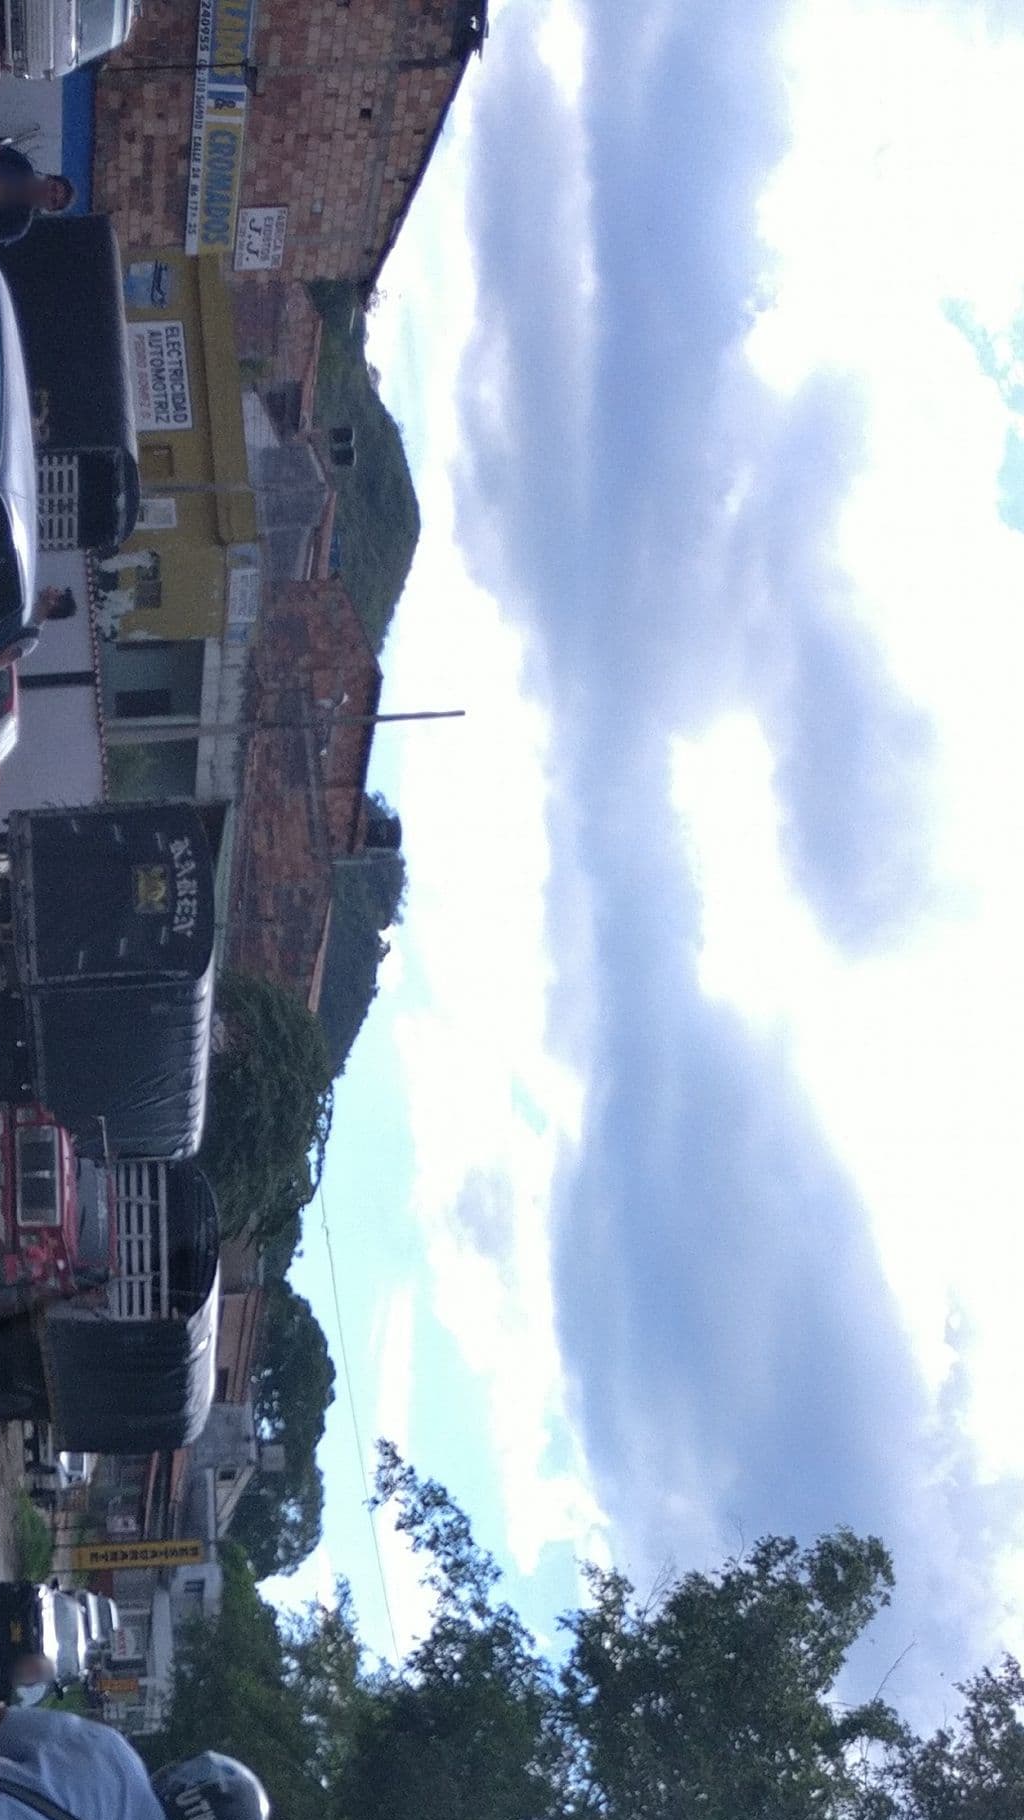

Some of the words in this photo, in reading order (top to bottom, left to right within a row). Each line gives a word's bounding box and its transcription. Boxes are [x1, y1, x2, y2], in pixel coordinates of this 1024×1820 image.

[214, 98, 236, 109] &
[202, 130, 239, 245] CROMADOS
[148, 330, 170, 424] AUTOMOTRIZ
[165, 326, 188, 424] ELECTRICIDAD
[169, 837, 198, 938] KAREN
[90, 1546, 200, 1562] RESTAURANTE
